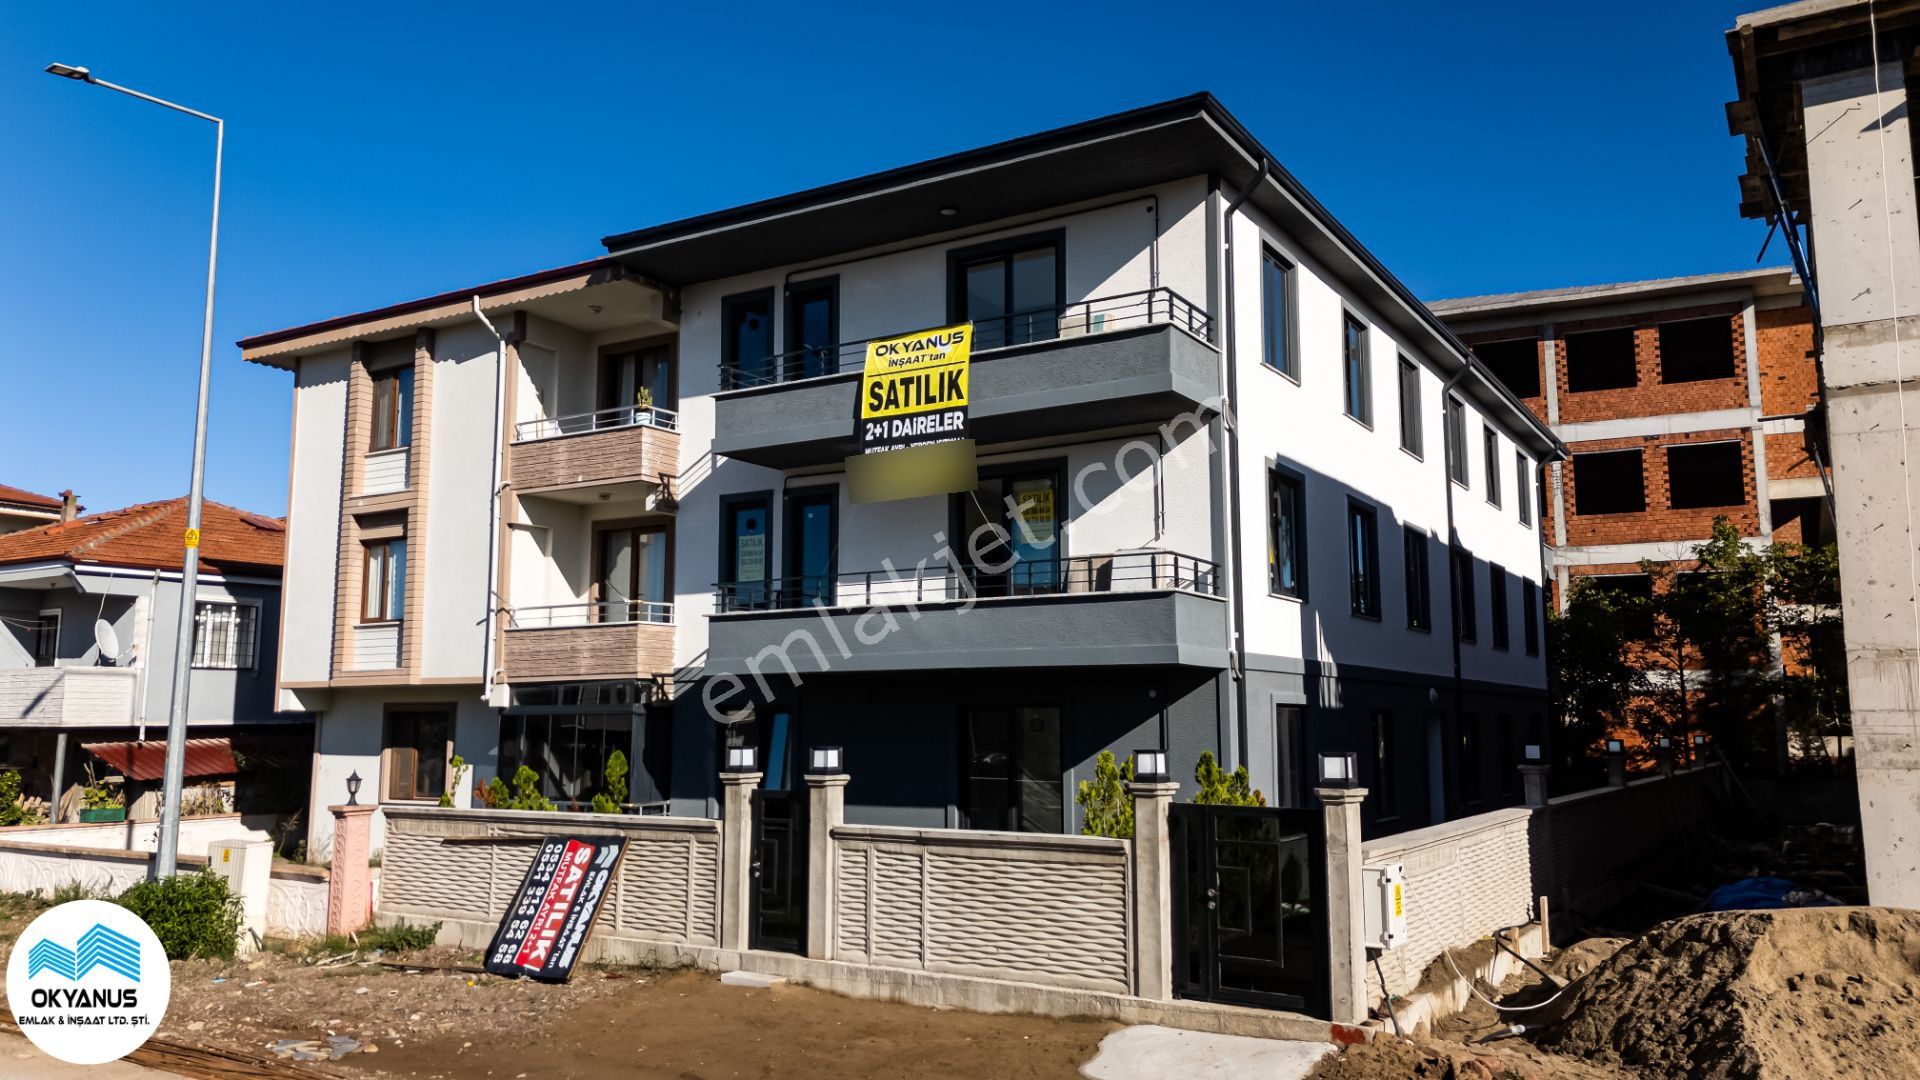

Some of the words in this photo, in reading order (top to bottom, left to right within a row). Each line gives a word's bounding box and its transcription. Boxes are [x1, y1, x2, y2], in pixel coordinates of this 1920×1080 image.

[875, 331, 964, 357] OKYANUS
[868, 368, 964, 412] SATILIK
[865, 421, 888, 440] 2+1
[533, 844, 554, 880] 0541
[542, 844, 562, 882] 0534
[547, 852, 572, 900] MUTFAK
[526, 886, 544, 915] 914
[530, 847, 591, 960] SATILIK
[578, 871, 596, 904] EMLAK
[514, 920, 530, 939] 62
[534, 903, 550, 930] AYRI
[558, 870, 608, 968] OKYANUS
[522, 934, 536, 953] 2+1
